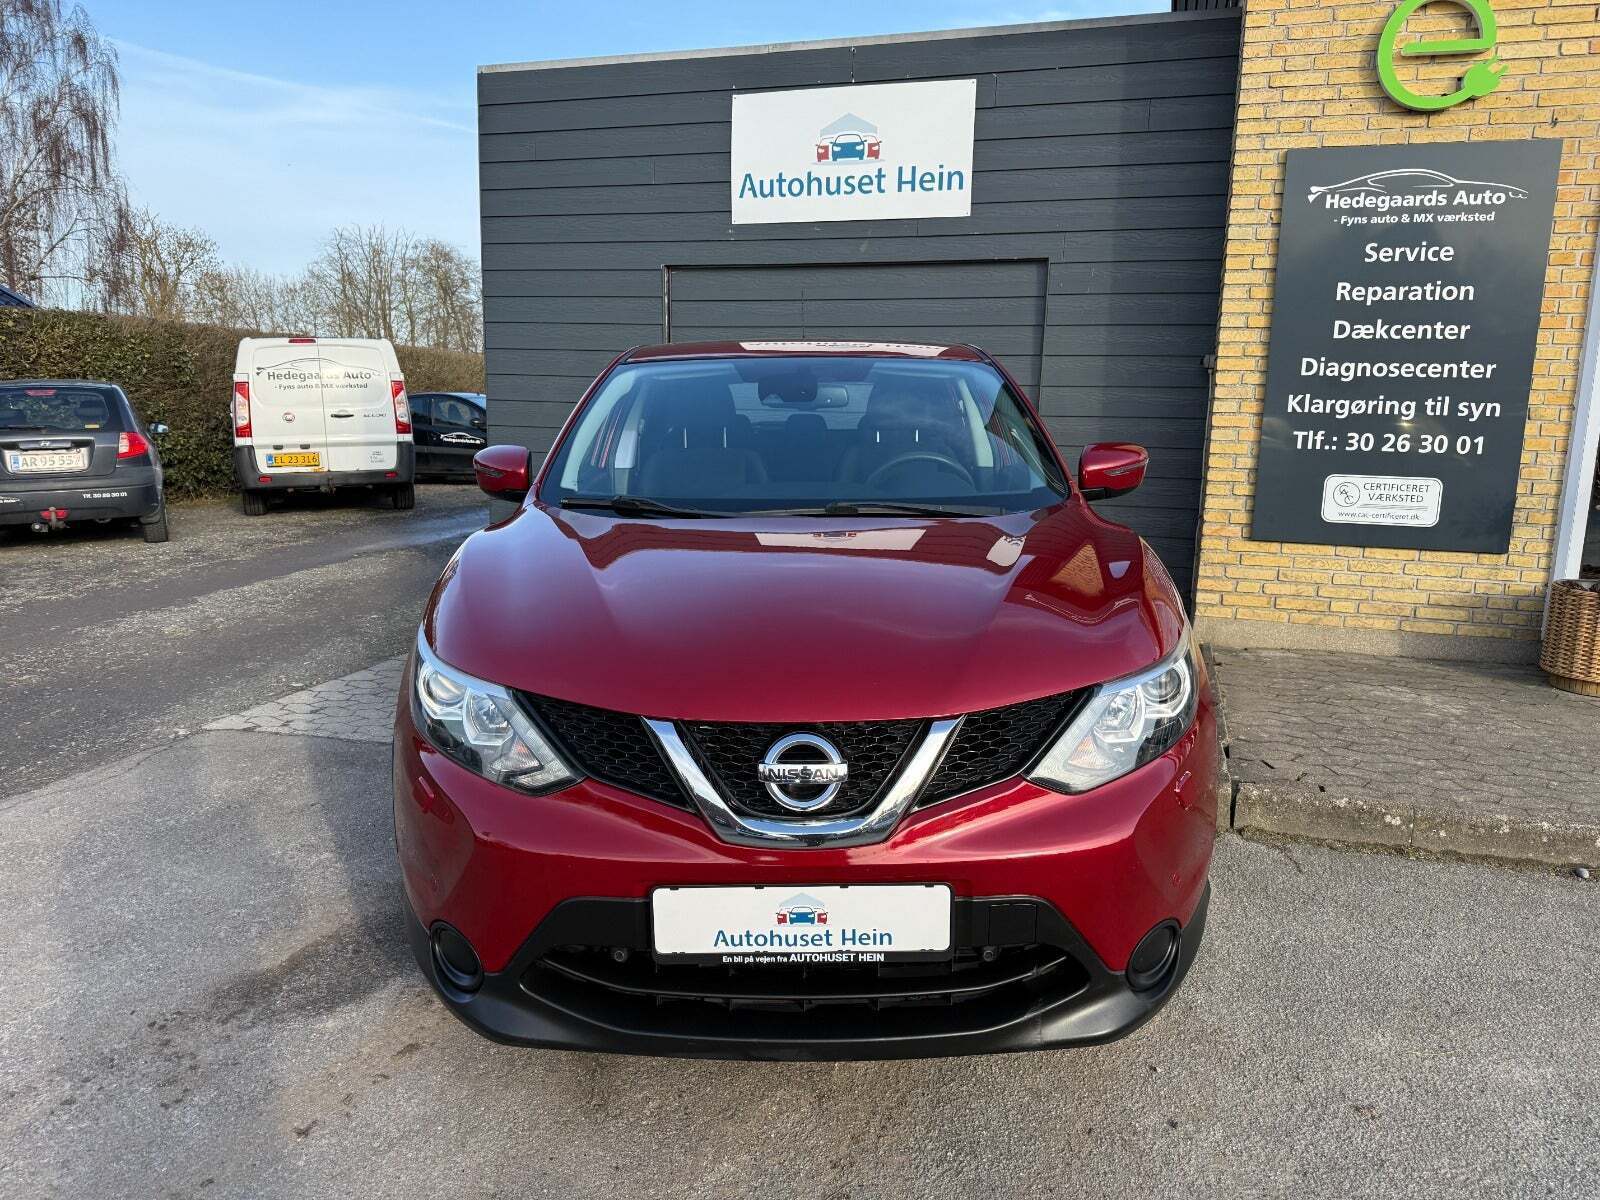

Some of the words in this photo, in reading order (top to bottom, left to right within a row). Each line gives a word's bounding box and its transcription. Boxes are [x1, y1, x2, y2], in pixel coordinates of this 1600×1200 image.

[739, 167, 886, 199] Autohuset
[897, 164, 964, 193] Hein
[1325, 189, 1447, 212] Hedegaards
[1452, 189, 1506, 206] Auto
[1340, 214, 1368, 226] Fyns
[1370, 214, 1398, 225] auto
[1401, 213, 1411, 223] &
[1413, 213, 1434, 223] MX
[1436, 211, 1495, 223] værksted
[1364, 241, 1455, 263] Service
[1335, 281, 1475, 306] Reparation
[1333, 319, 1471, 341] Dækcenter
[343, 371, 372, 380] Auto
[1300, 356, 1497, 381] Diagnosecenter
[1287, 394, 1416, 420] Klargøring
[1424, 396, 1449, 416] til
[1457, 400, 1501, 421] syn
[1293, 430, 1338, 451] Tlf.:
[1345, 432, 1375, 452] 30
[1381, 433, 1411, 453] 26
[1418, 434, 1448, 454] 30
[1456, 435, 1485, 455] 01
[22, 457, 37, 468] AR
[274, 456, 285, 464] EL
[287, 455, 299, 464] 23
[301, 455, 317, 464] 316
[1363, 482, 1431, 493] CERTIFICERET
[1368, 493, 1424, 503] VÆRKSTED
[1338, 511, 1420, 520] www.cac-certificeret.dk
[767, 767, 839, 780] NISSAN
[713, 928, 833, 947] Autohuset
[841, 928, 893, 946] Hein
[722, 955, 733, 963] En
[733, 955, 743, 963] bil
[744, 955, 755, 965] på
[755, 955, 776, 965] vejen
[777, 955, 787, 963] fra
[789, 953, 855, 962] AUTOHUSET
[858, 953, 885, 962] HEIN
